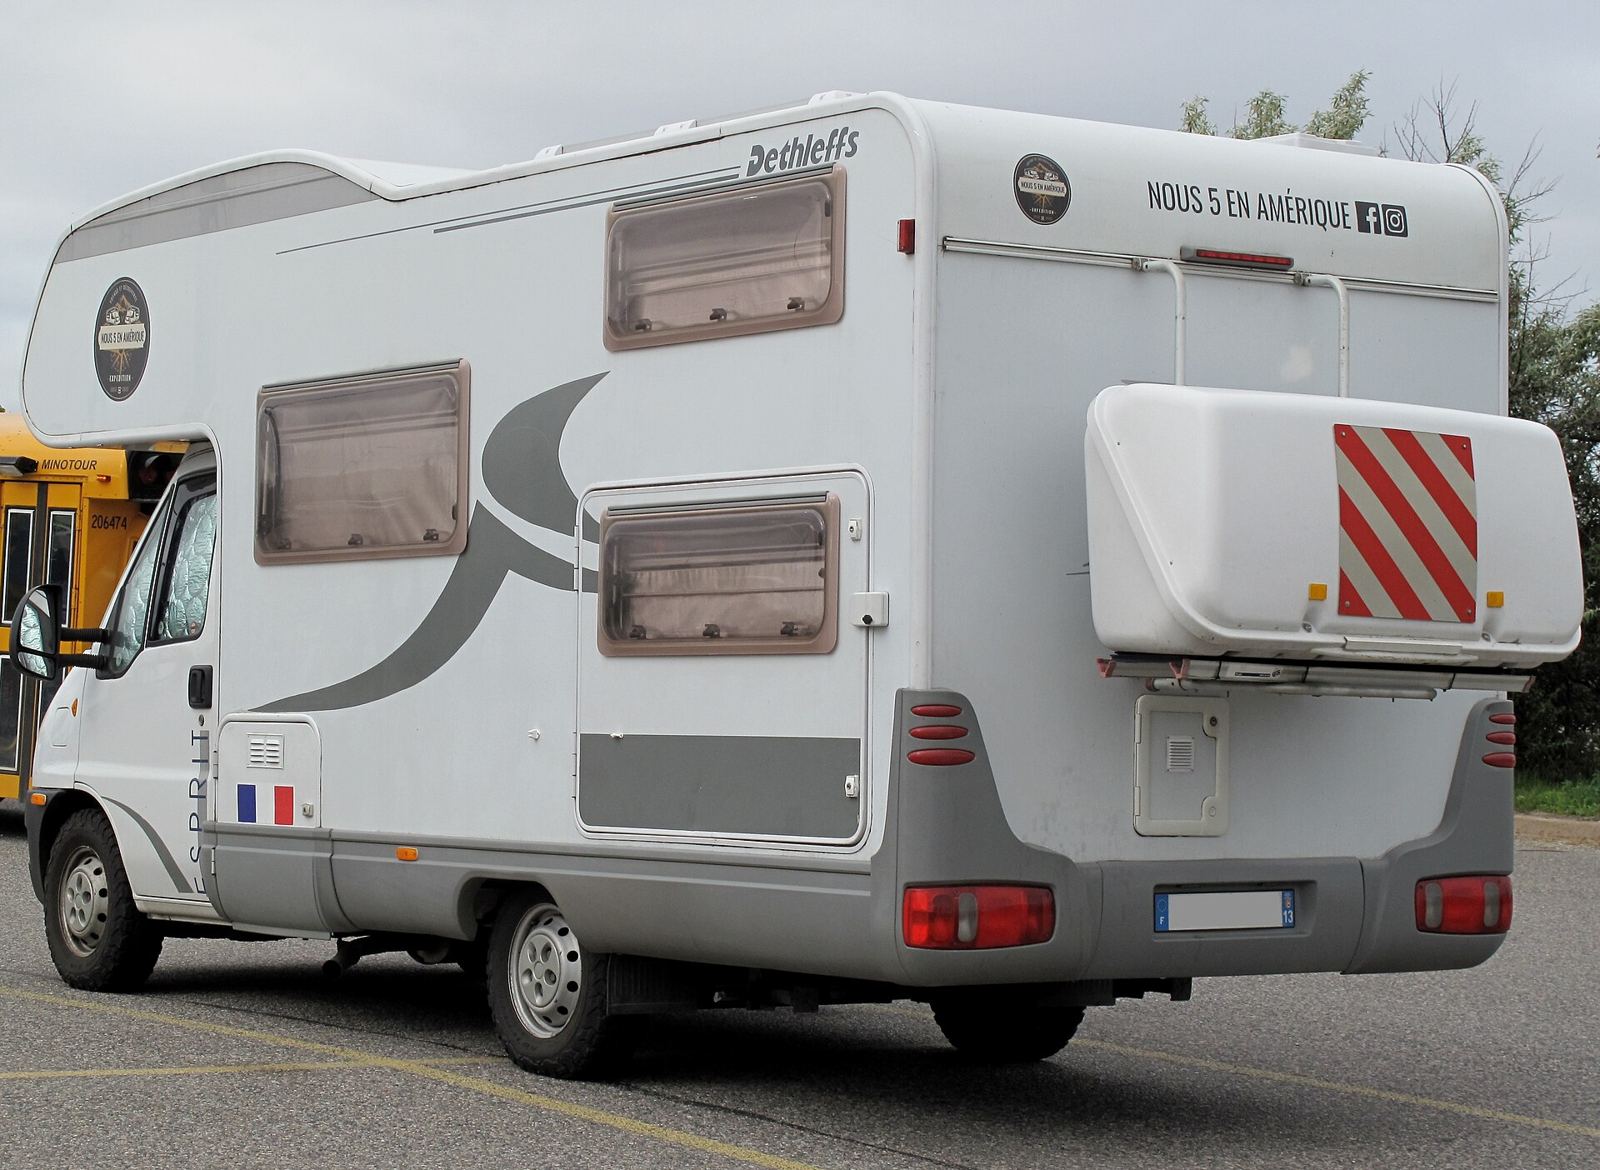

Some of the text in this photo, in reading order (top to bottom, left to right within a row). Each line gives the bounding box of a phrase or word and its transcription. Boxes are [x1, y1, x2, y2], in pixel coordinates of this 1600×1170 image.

[747, 126, 860, 177] Dethleffs
[1147, 181, 1203, 214] NOUS
[1208, 187, 1221, 216] 5
[1226, 189, 1251, 219] EN
[1257, 188, 1352, 231] AMÉRIQUE
[41, 459, 97, 470] MINOTOUR
[91, 514, 127, 530] 206474
[1159, 916, 1165, 925] F
[1283, 910, 1293, 923] 13
